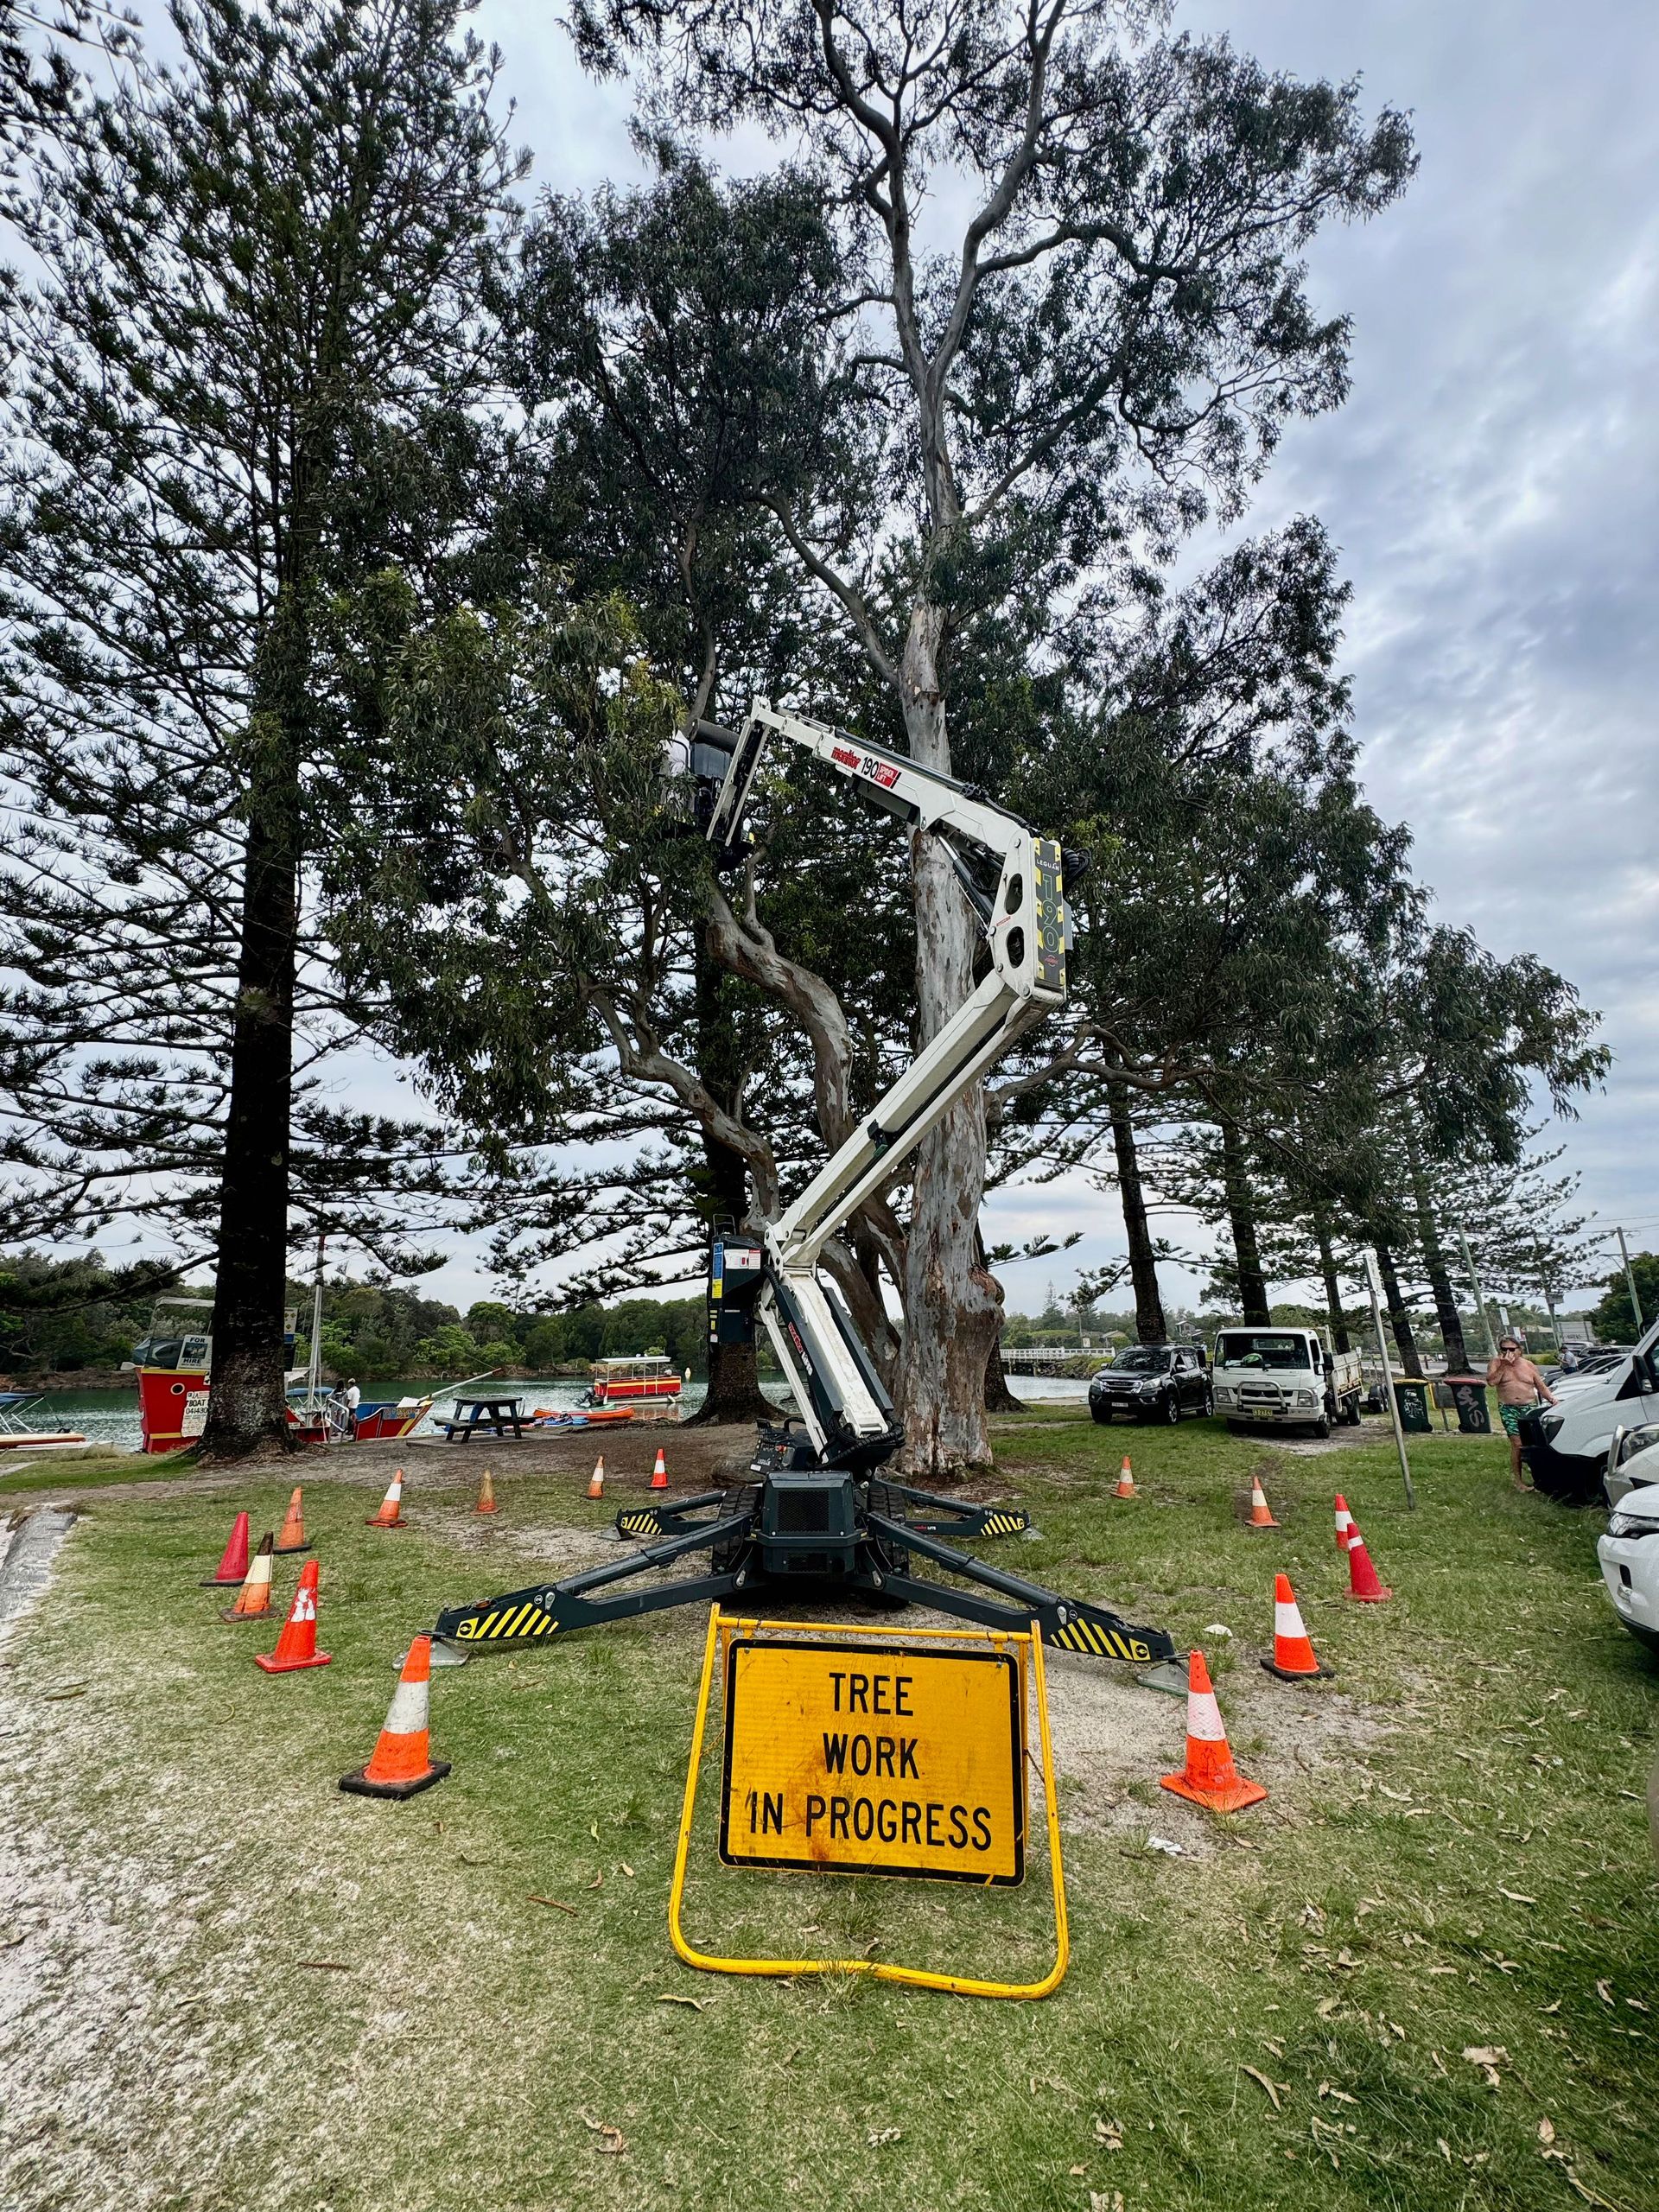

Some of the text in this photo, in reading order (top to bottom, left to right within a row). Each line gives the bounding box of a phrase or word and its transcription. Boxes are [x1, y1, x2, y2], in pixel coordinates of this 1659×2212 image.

[861, 757, 879, 779] 190
[1036, 859, 1059, 871] LEGUAN
[1042, 874, 1059, 953] 190
[829, 1672, 913, 1716] TREE
[823, 1732, 919, 1779] WORK
[750, 1791, 991, 1851] IN PROGRESS
